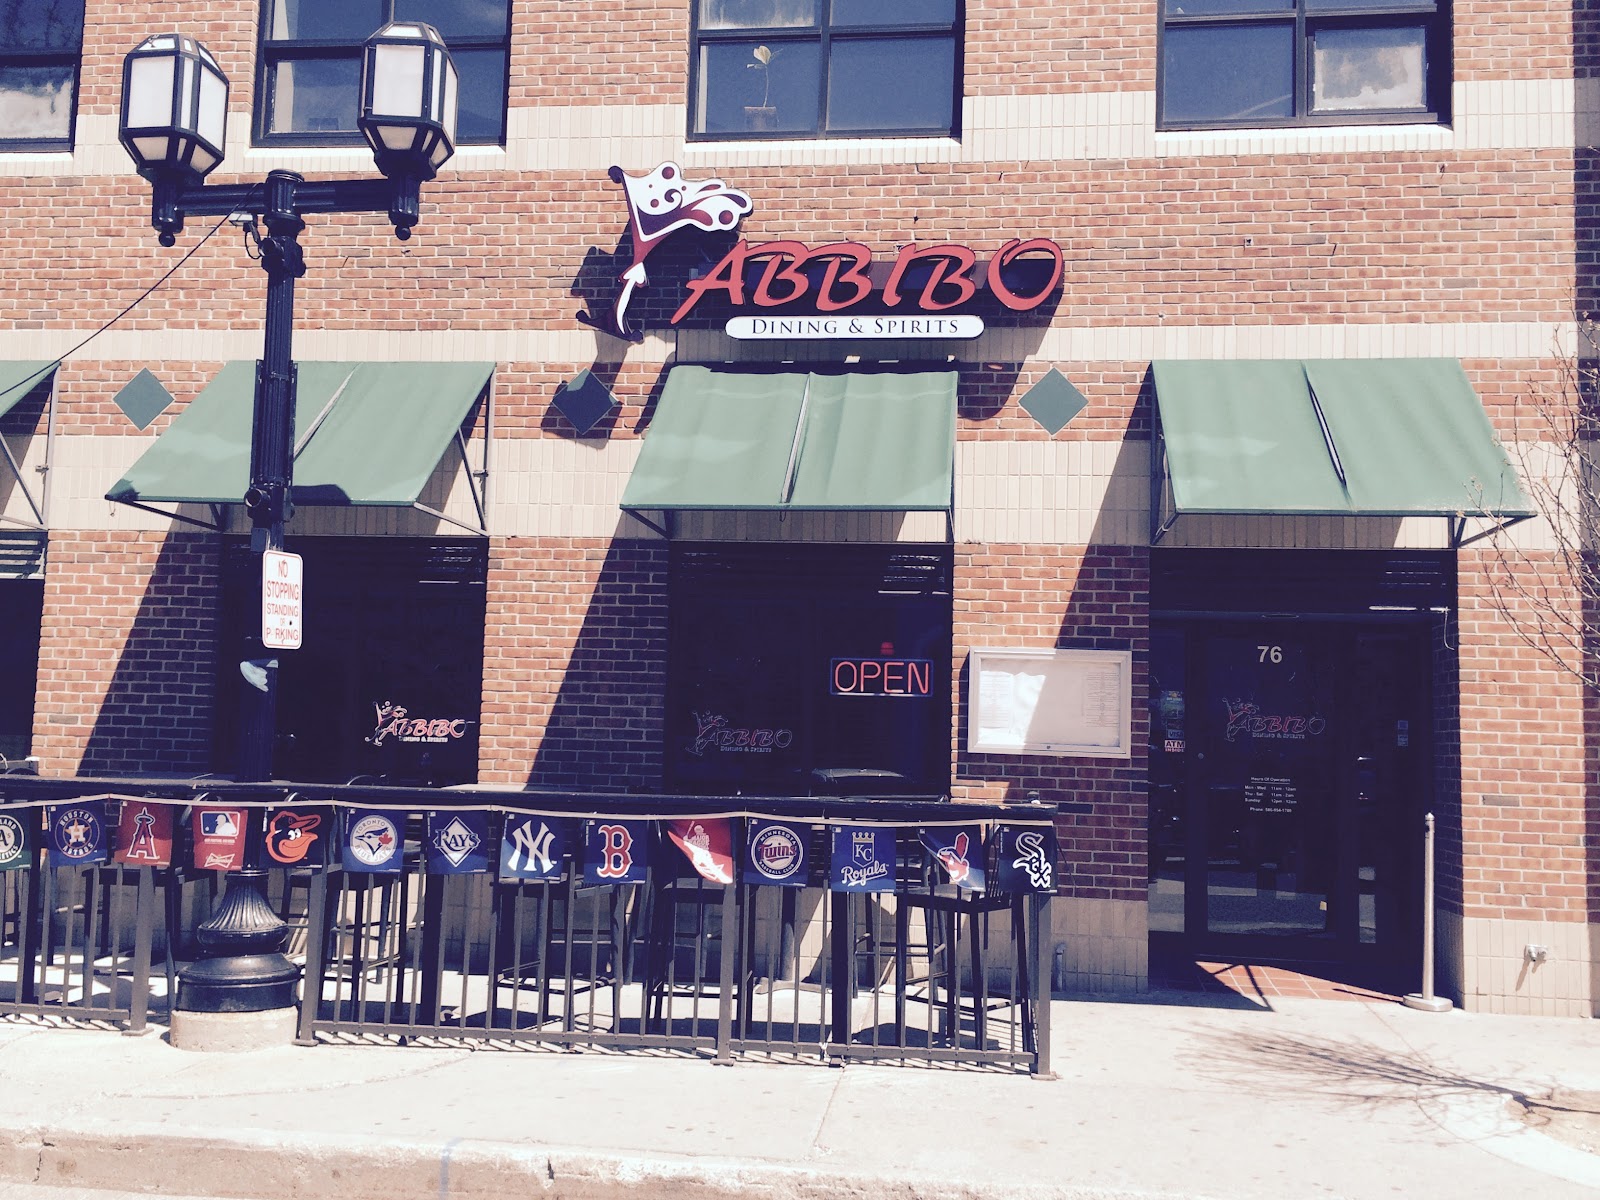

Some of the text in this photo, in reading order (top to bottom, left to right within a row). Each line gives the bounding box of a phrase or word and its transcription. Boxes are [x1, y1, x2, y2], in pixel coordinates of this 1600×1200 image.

[670, 238, 1065, 325] ABBIBO
[752, 318, 959, 335] DINING & SPIRITS
[278, 560, 289, 578] NO
[266, 580, 299, 600] STOPPING
[266, 603, 299, 617] STANDING
[279, 617, 286, 625] OR
[266, 627, 299, 641] PRKING
[1257, 645, 1283, 664] 76
[834, 661, 929, 694] OPEN
[1231, 714, 1326, 736] ABBIBO
[700, 728, 793, 749] ABBIBO
[59, 811, 94, 826] HOUSTON
[356, 819, 386, 834] TORONTO
[127, 807, 158, 859] A
[435, 829, 479, 852] RAYS
[760, 830, 797, 845] MINNESOTA
[62, 842, 94, 856] ASTROS
[355, 845, 372, 860] BLUE
[597, 825, 633, 878] B
[758, 842, 797, 863] Twins
[855, 844, 872, 861] KC
[759, 861, 795, 875] BASEBALL CLUB
[841, 860, 888, 887] Royals
